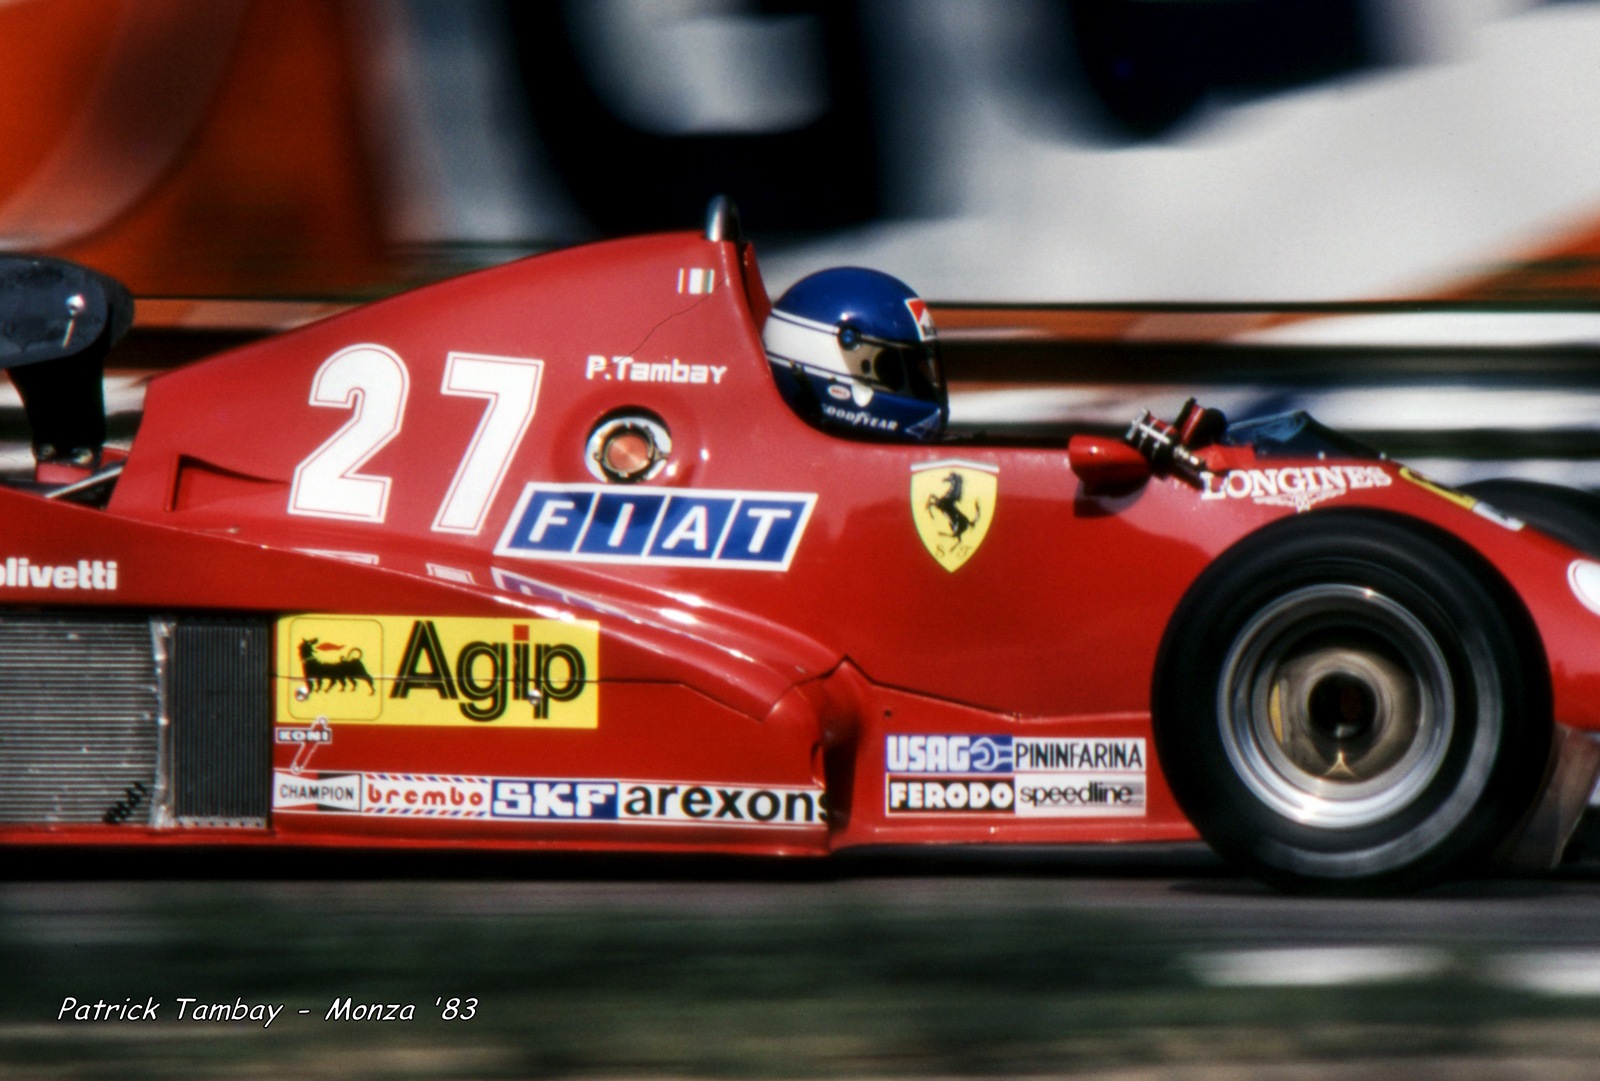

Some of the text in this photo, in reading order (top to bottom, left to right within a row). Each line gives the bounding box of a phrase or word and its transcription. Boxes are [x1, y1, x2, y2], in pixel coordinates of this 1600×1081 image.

[586, 355, 728, 385] P.Tambay
[287, 343, 544, 536] 27
[527, 500, 791, 553] FIAT
[0, 557, 118, 590] livetti
[389, 620, 587, 721] Agip
[279, 730, 329, 742] KONI
[886, 735, 971, 772] USAG
[1015, 742, 1143, 769] PININFARINA
[280, 784, 354, 801] CHAMPION
[367, 783, 484, 807] brembo
[493, 782, 617, 817] SKF
[889, 782, 1014, 809] FERODO
[1019, 781, 1133, 808] speedline
